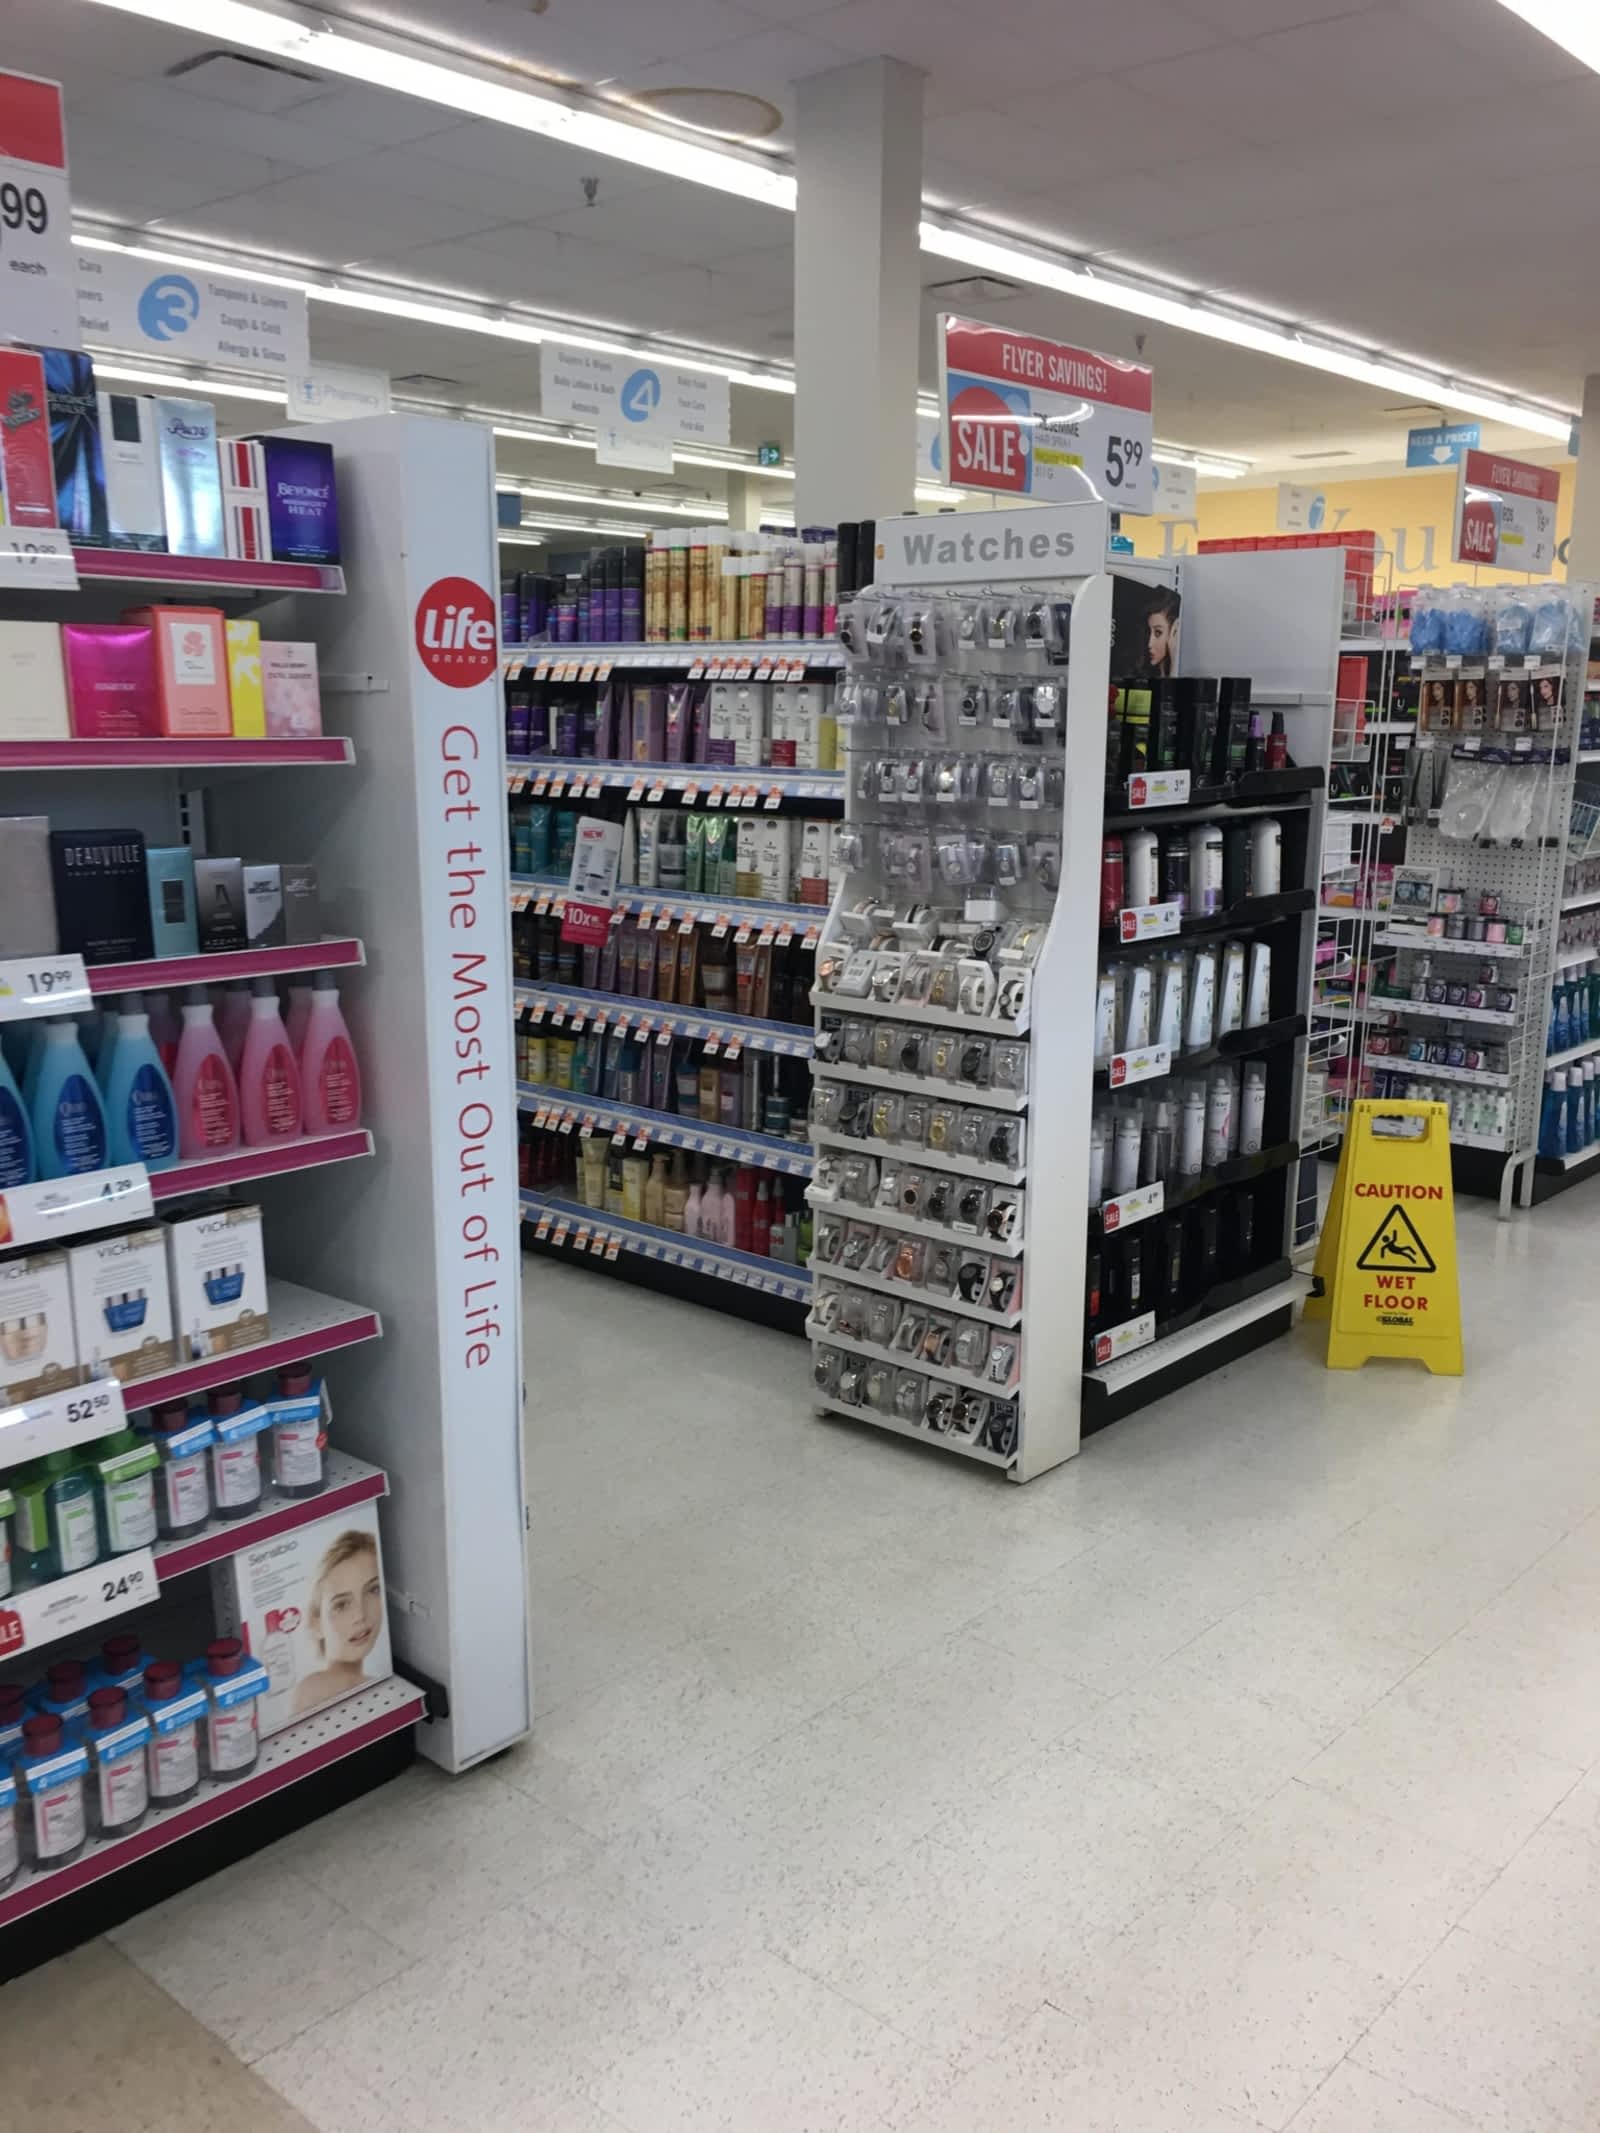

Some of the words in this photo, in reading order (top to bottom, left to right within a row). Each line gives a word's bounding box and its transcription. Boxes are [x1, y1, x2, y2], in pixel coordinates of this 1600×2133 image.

[9, 258, 47, 278] each
[217, 341, 249, 358] Allergy
[1002, 343, 1044, 380] FLYER
[1048, 357, 1107, 394] SAVINGS!
[957, 420, 1016, 477] SALE
[1410, 435, 1433, 446] NEED
[1436, 434, 1443, 445] A
[1445, 431, 1478, 443] PRICE?
[288, 506, 323, 517] HEAT
[1465, 518, 1493, 553] SALE
[902, 528, 1075, 567] Watches
[422, 604, 495, 651] Life
[431, 654, 489, 665] BRAND
[440, 724, 481, 822] Get
[1131, 787, 1147, 800] SALE
[446, 841, 487, 929] the
[567, 907, 591, 927] 10x
[1123, 919, 1136, 932] SALE
[451, 953, 492, 1085] Most
[1112, 1065, 1126, 1078] SALE
[457, 1102, 495, 1198] Out
[1354, 1183, 1444, 1201] CAUTION
[1106, 1210, 1120, 1225] SALE
[462, 1215, 499, 1262] of
[1376, 1275, 1416, 1290] WET
[1363, 1294, 1428, 1311] FLOOR
[464, 1279, 501, 1370] Life
[1098, 1343, 1111, 1357] SALE
